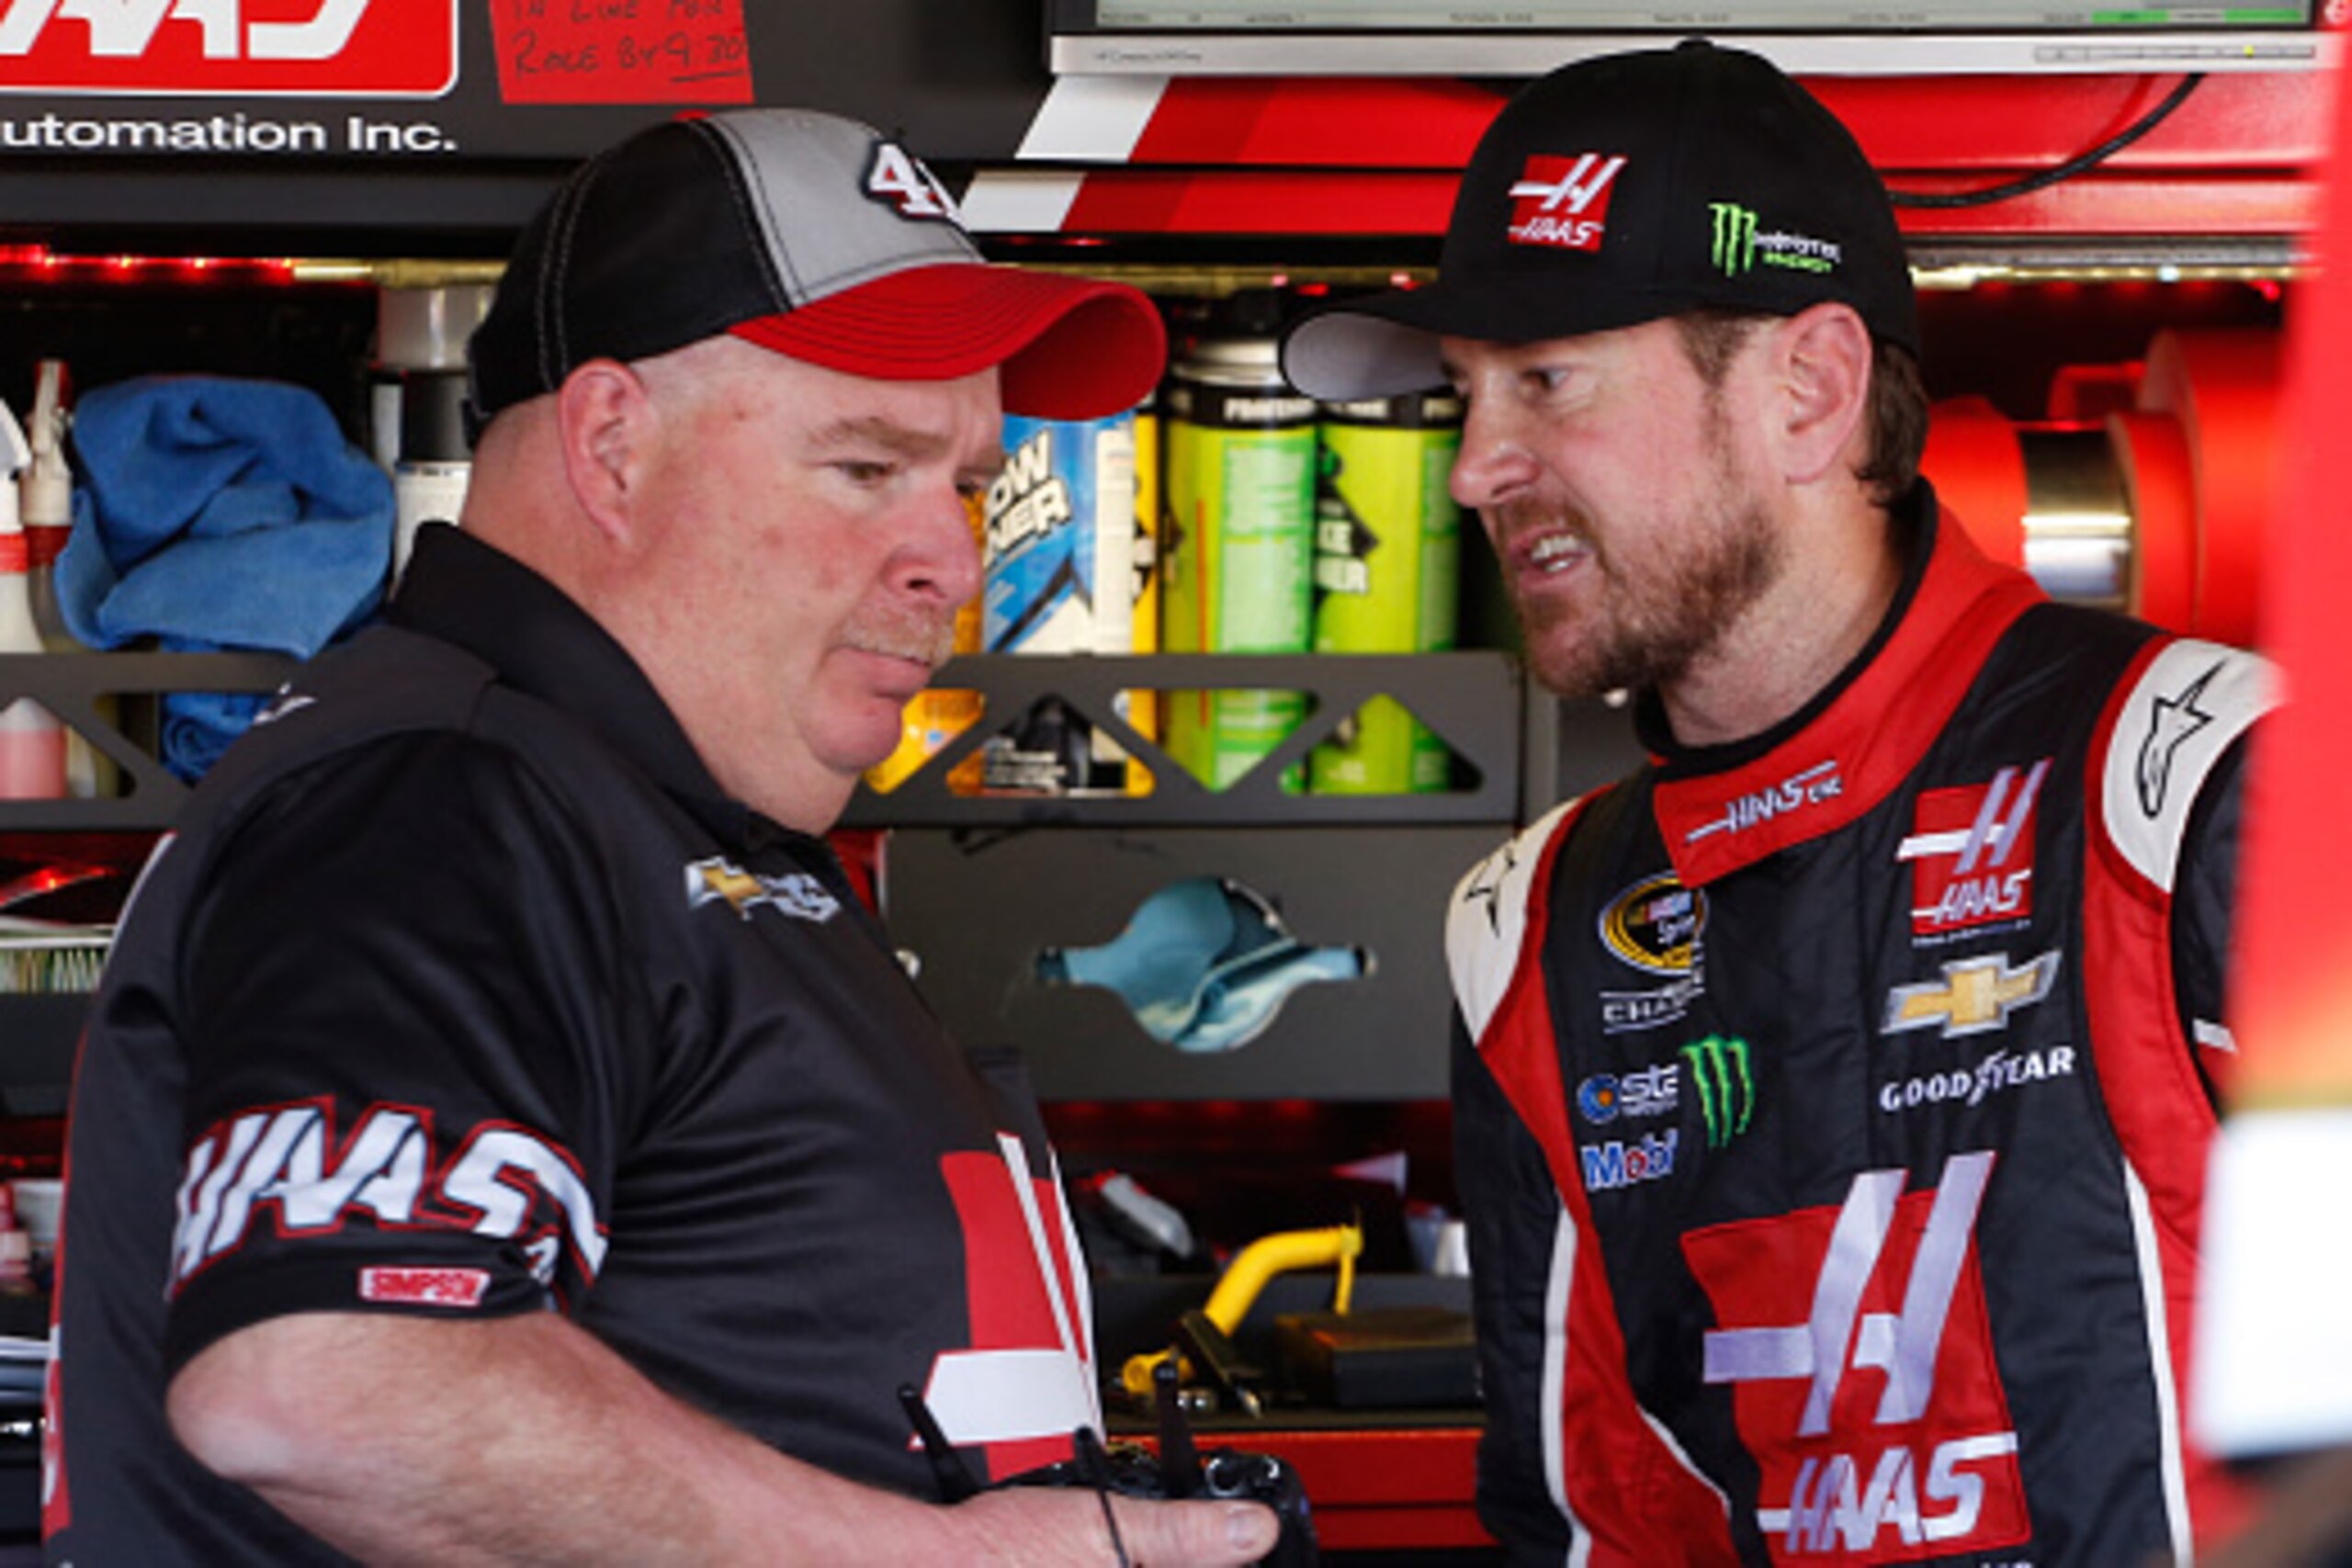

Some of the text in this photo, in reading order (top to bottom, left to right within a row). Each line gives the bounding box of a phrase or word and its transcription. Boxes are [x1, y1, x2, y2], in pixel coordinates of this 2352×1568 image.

[347, 117, 457, 151] Inc.
[1911, 868, 2031, 925] HAAS
[1756, 1430, 2018, 1554] HAAS
